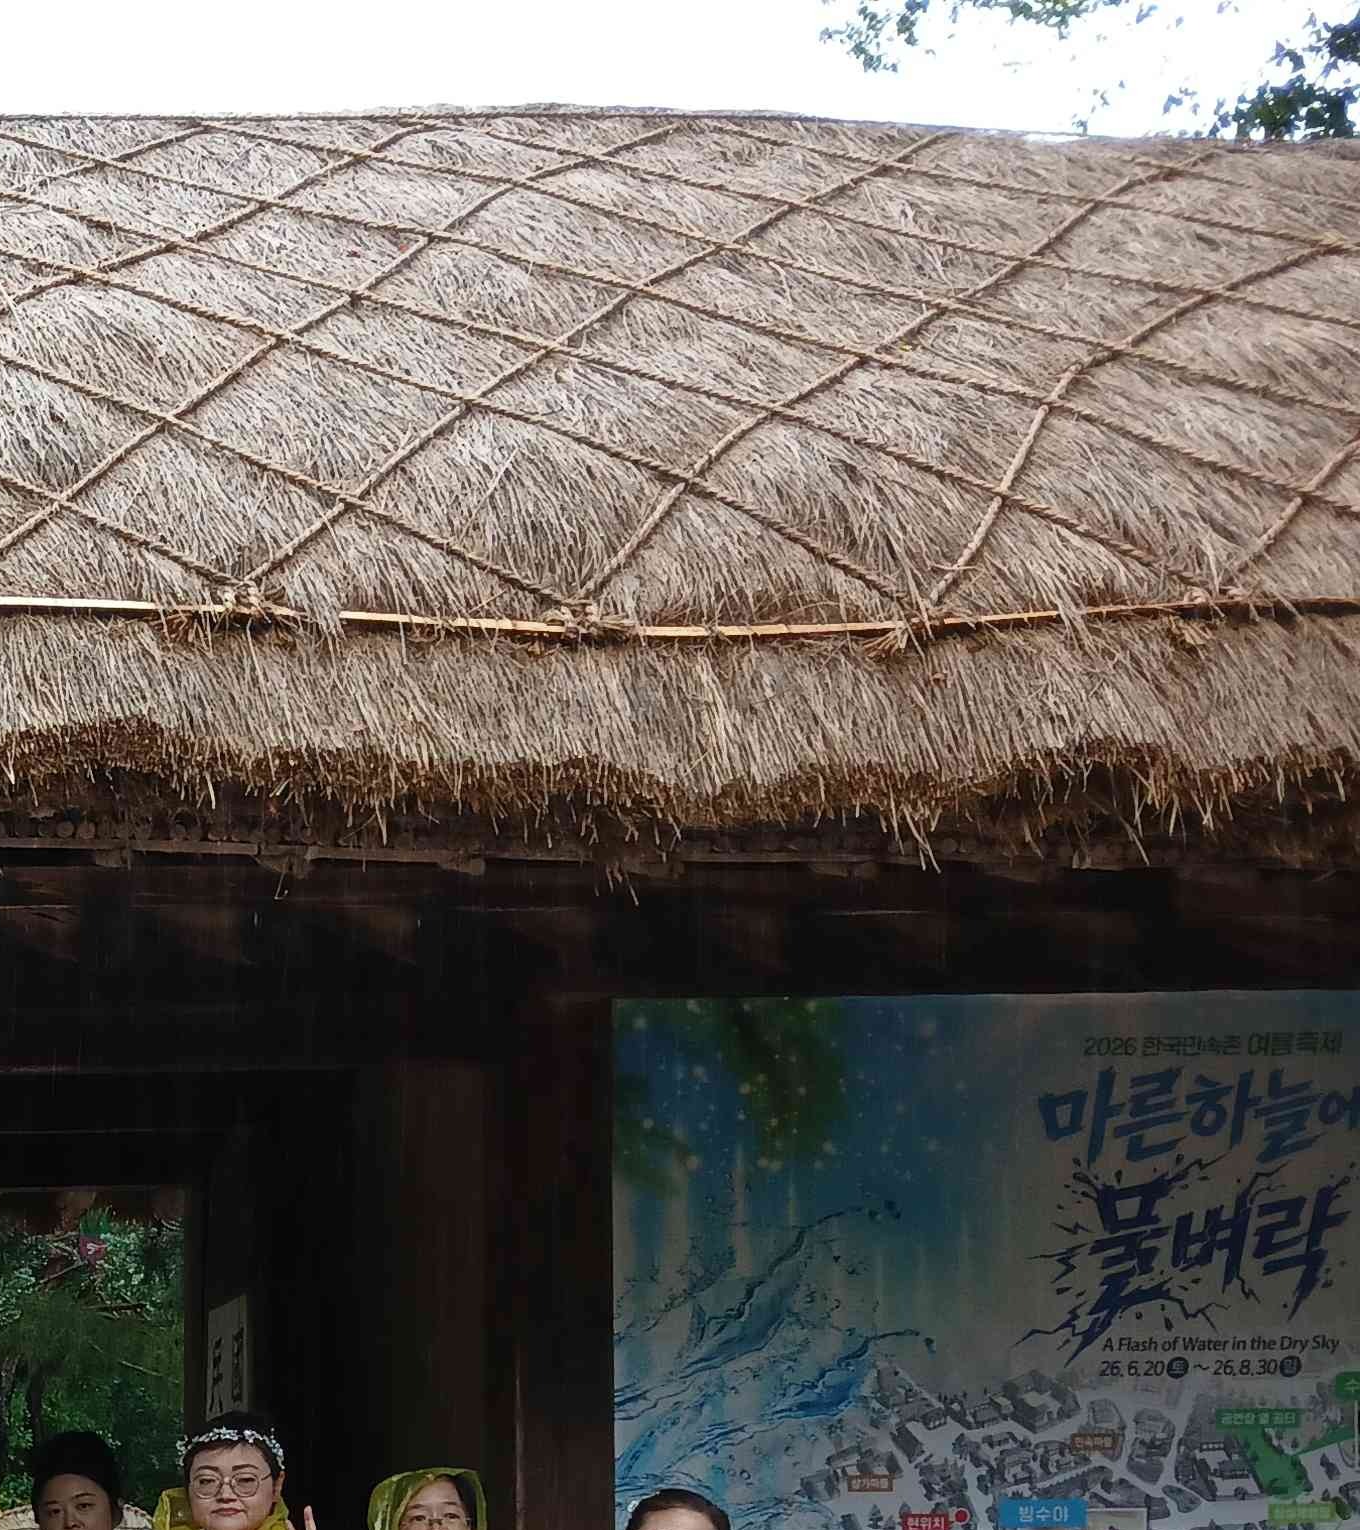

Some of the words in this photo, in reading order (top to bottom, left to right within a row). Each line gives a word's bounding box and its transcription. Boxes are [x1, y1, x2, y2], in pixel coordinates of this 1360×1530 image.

[1083, 1036, 1137, 1057] 2026
[1102, 1337, 1114, 1352] A
[1118, 1336, 1158, 1352] Flash
[1161, 1336, 1178, 1352] of
[1182, 1336, 1229, 1352] Water
[1231, 1335, 1247, 1351] in
[1249, 1335, 1277, 1351] the
[1280, 1335, 1308, 1355] Dry
[1311, 1334, 1341, 1354] Sky
